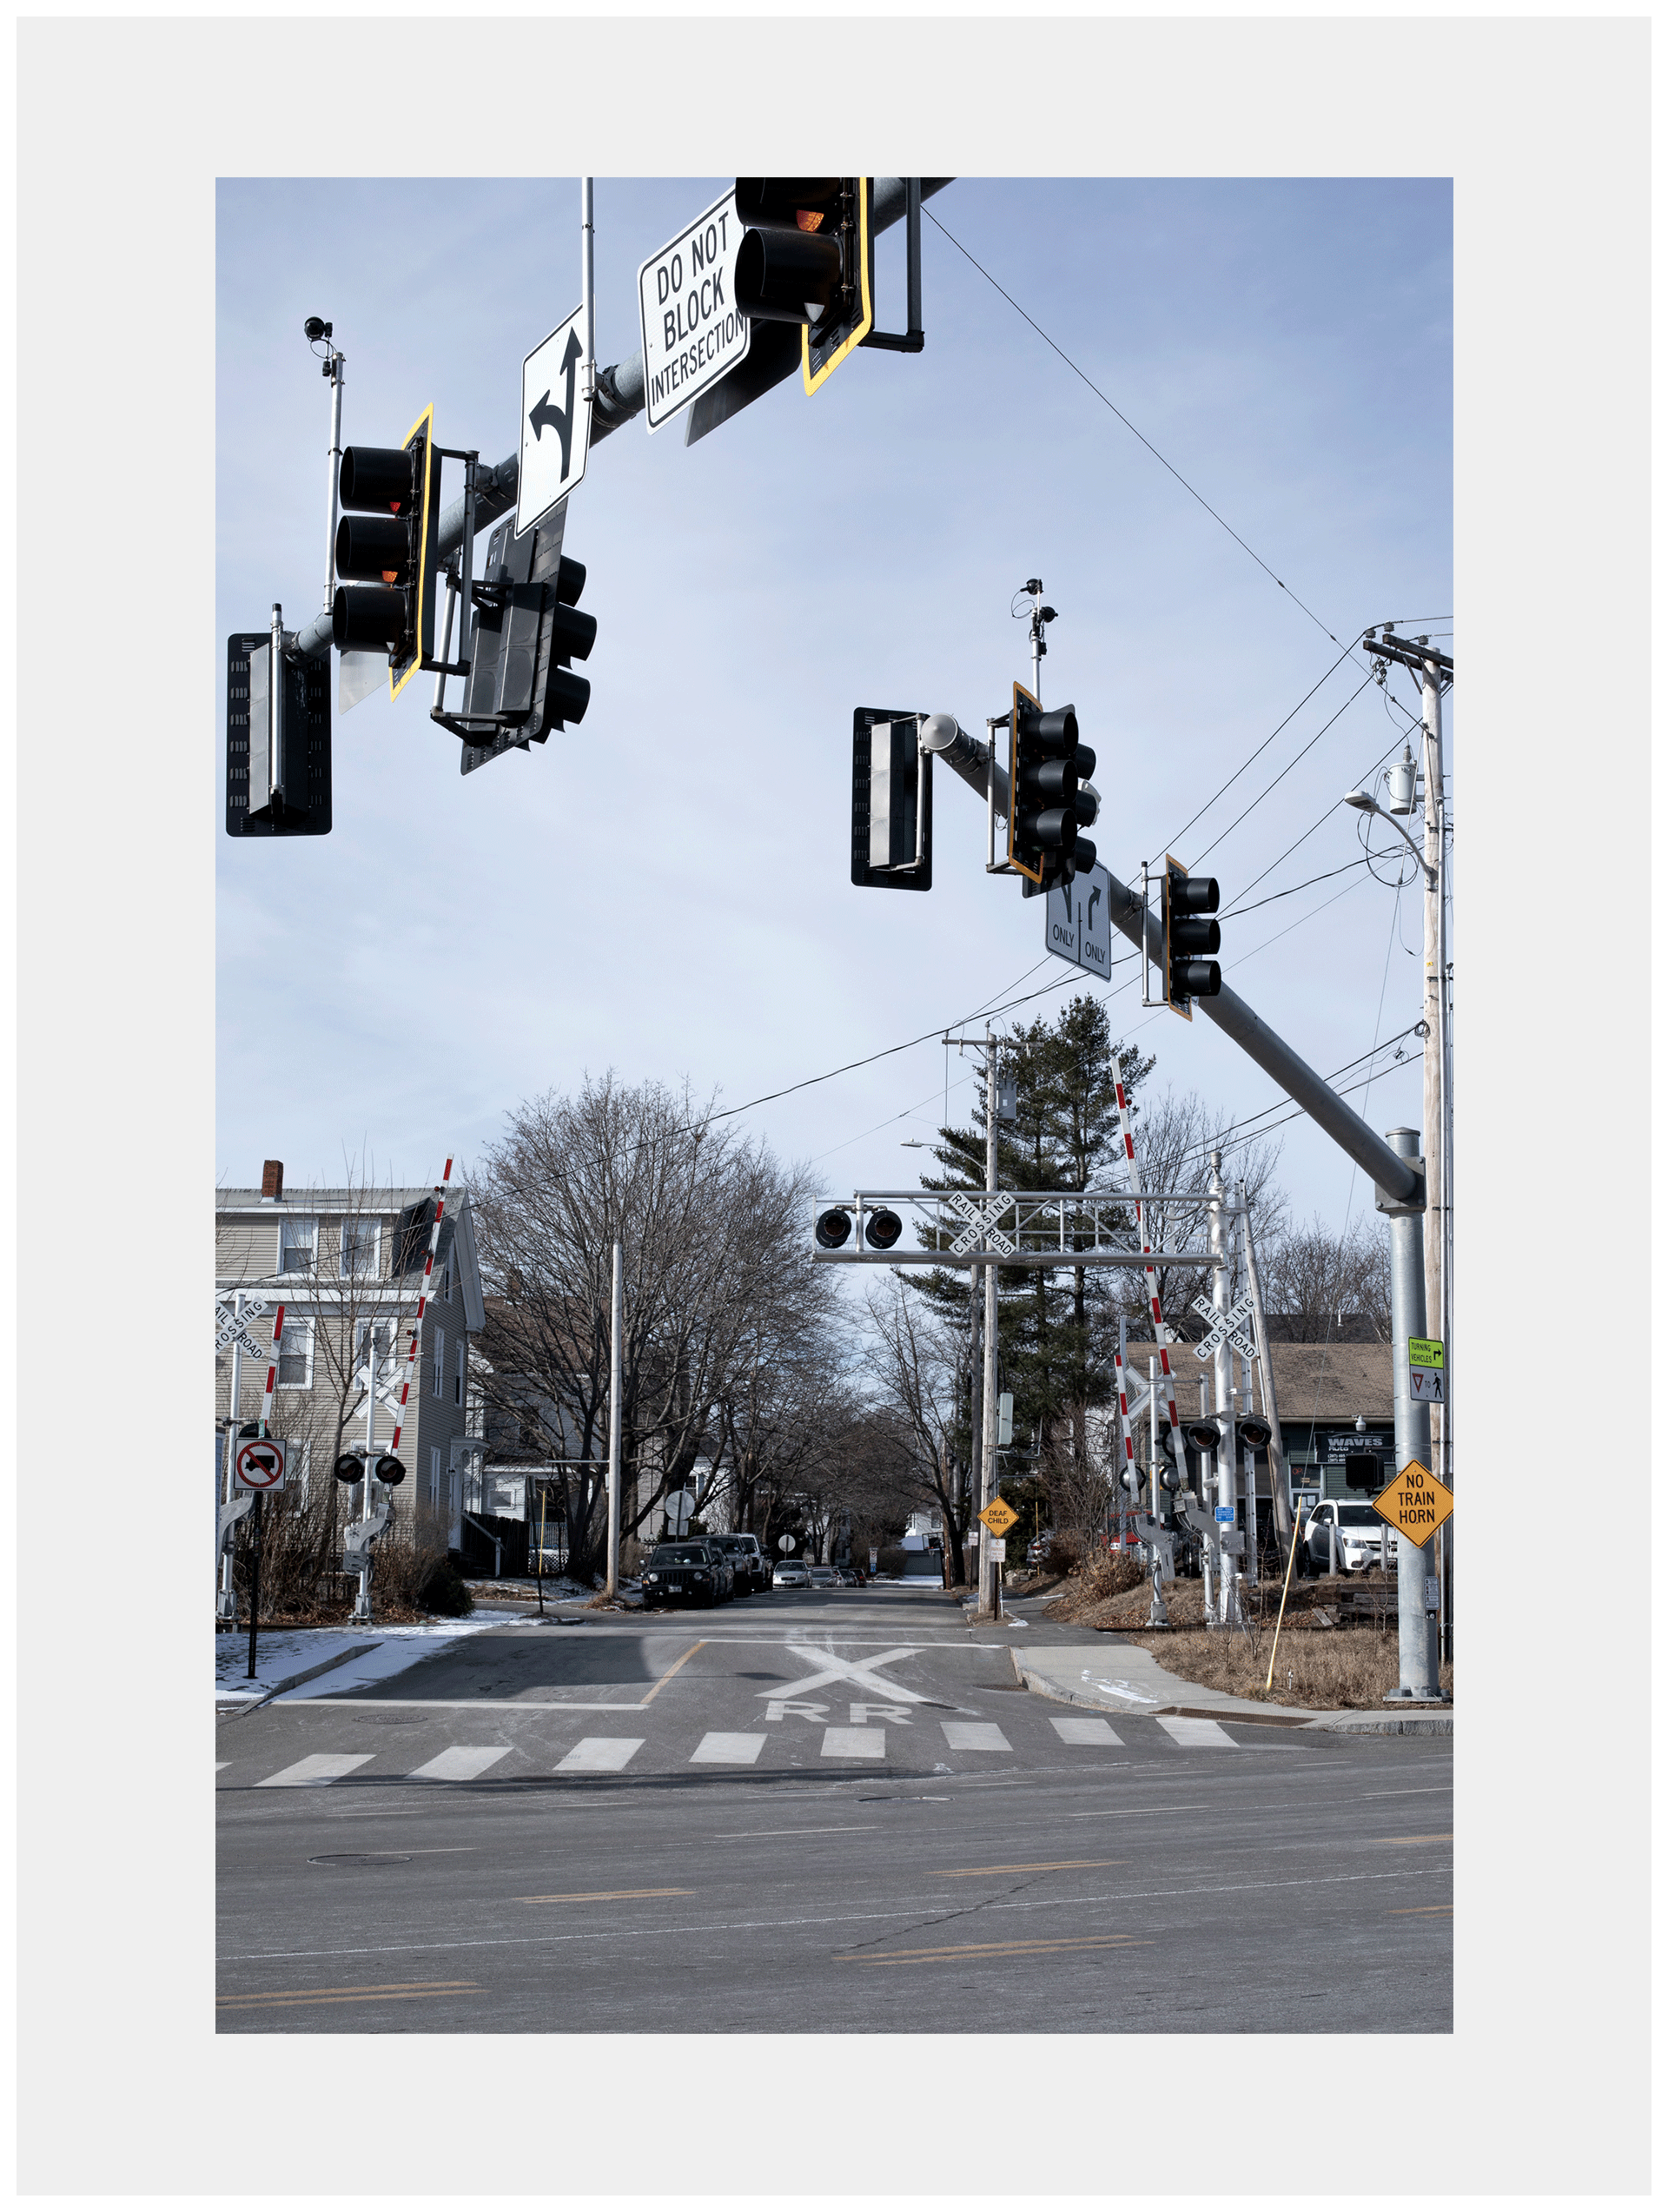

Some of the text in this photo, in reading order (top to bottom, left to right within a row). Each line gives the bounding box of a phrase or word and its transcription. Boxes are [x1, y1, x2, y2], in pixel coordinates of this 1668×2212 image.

[657, 210, 729, 306] DO NOT
[663, 266, 725, 352] BLOCK
[651, 307, 745, 407] INTERSECTION
[1052, 924, 1075, 949] ONLY
[1085, 941, 1106, 965] ONLY
[951, 1194, 1012, 1255] RAIL ROAD
[953, 1195, 1011, 1254] CROSSING
[215, 1301, 262, 1350] ROSSING
[215, 1306, 262, 1359] AIL ROAD
[1195, 1298, 1255, 1358] RAIL ROAD
[1197, 1297, 1254, 1358] CROSSING
[1411, 1341, 1432, 1353] TURNING
[1411, 1353, 1433, 1364] VEHICLES
[1425, 1380, 1432, 1389] TO
[1327, 1438, 1383, 1447] WAVES
[1397, 1491, 1435, 1507] TRAIN
[1406, 1474, 1424, 1488] NO
[1399, 1508, 1435, 1524] HORN
